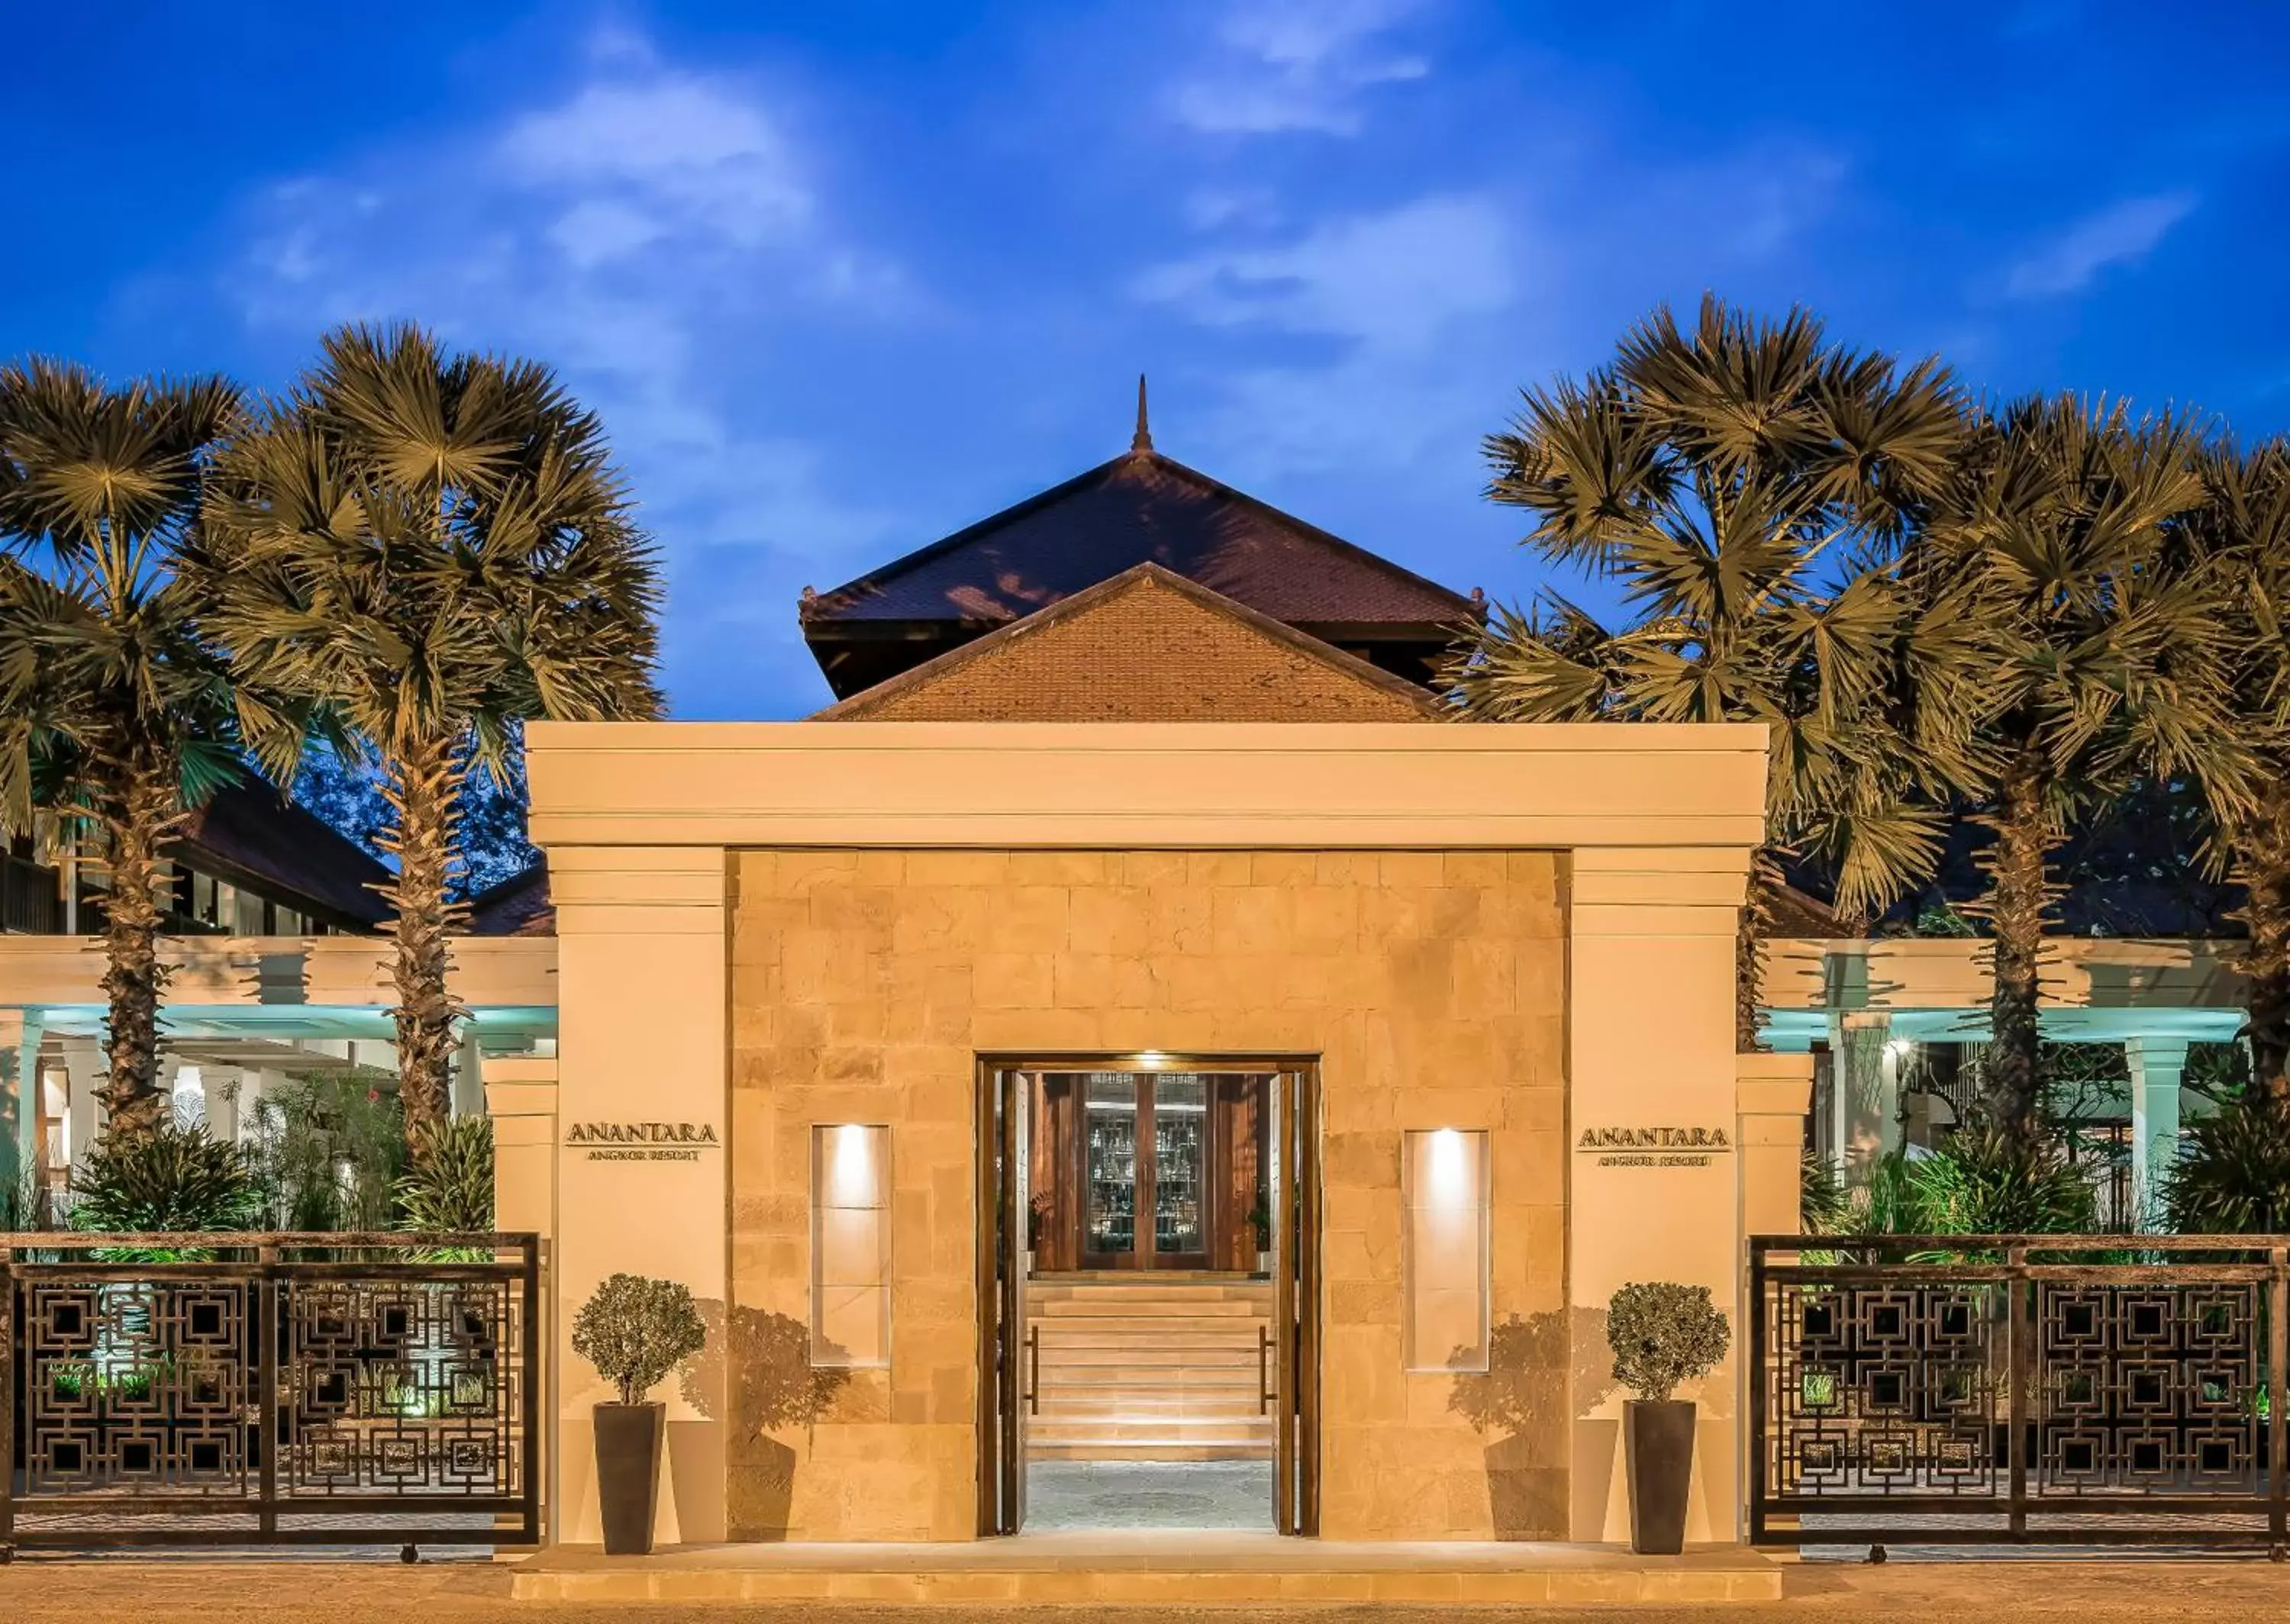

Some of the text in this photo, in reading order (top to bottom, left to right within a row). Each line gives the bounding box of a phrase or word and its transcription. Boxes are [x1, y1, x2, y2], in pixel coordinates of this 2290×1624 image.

[567, 1123, 718, 1142] ANANTARA
[1579, 1127, 1730, 1146] ANANTARA
[587, 1150, 646, 1160] ANGKOR
